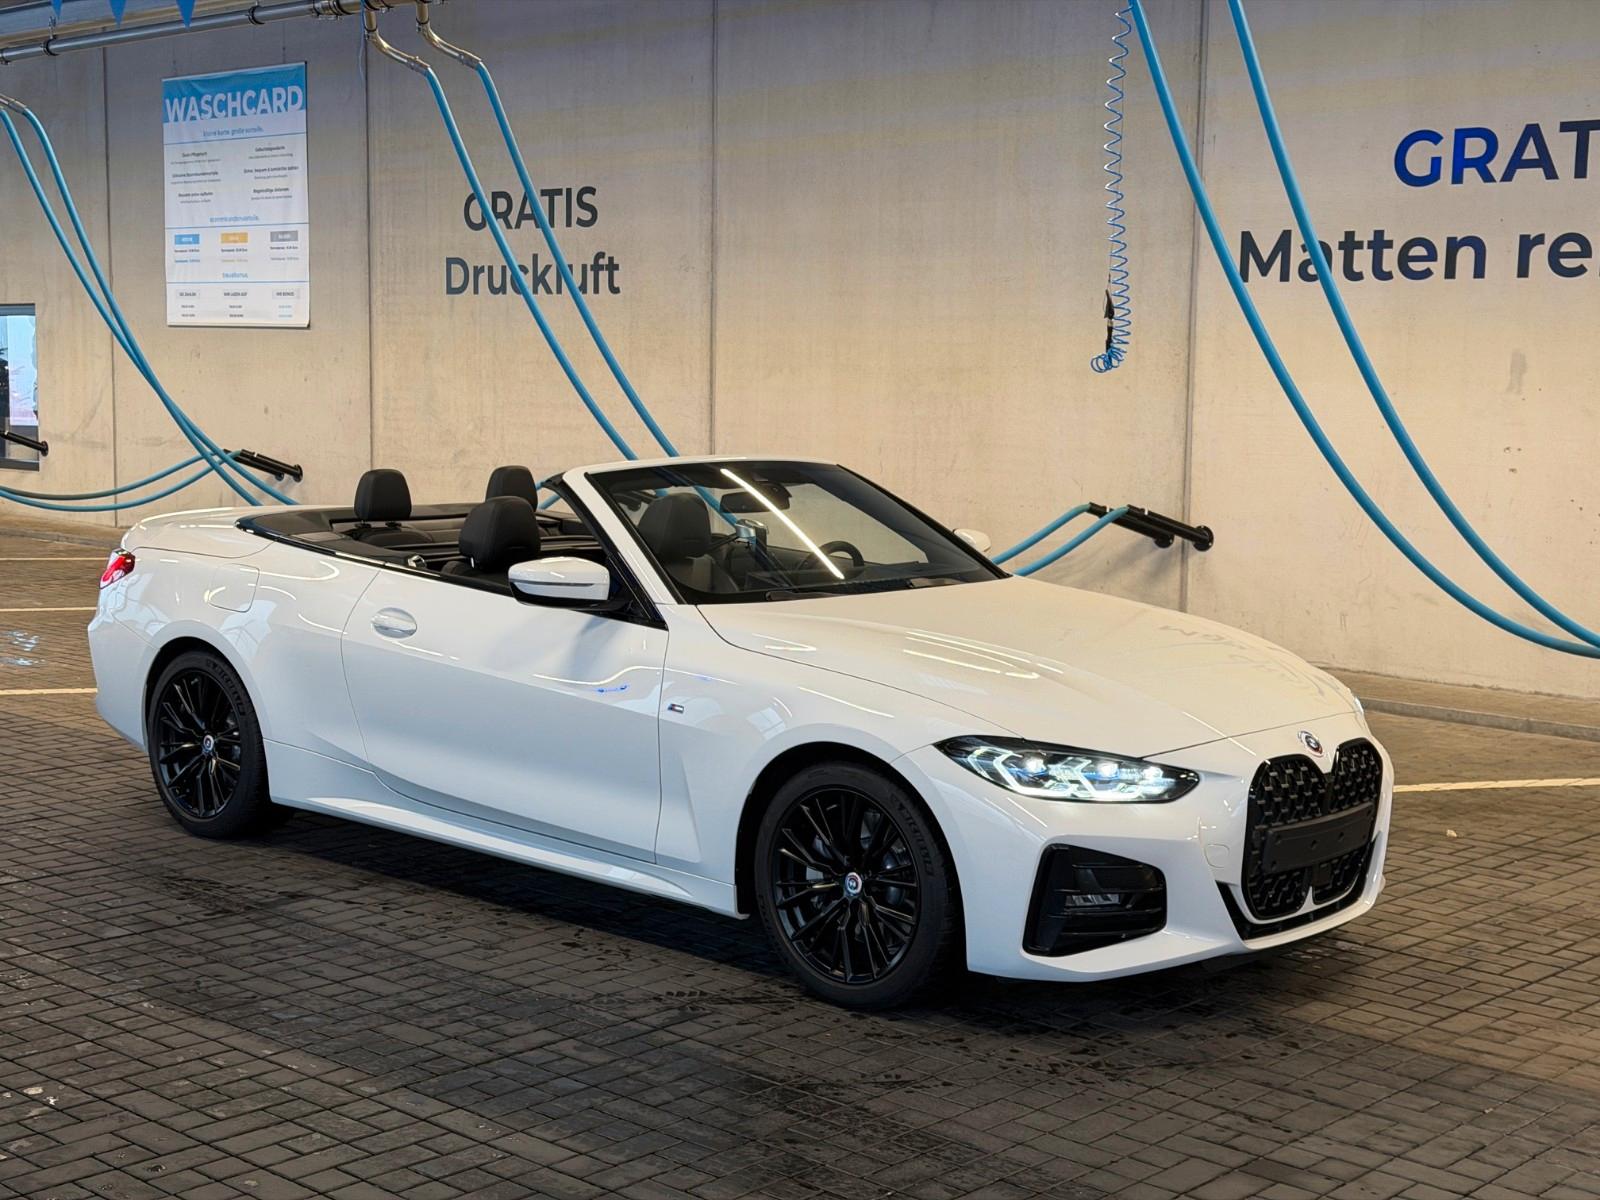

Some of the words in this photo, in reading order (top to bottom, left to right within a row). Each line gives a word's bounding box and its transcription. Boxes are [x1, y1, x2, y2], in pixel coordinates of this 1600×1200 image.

[165, 85, 303, 123] WASCHCARD
[1394, 119, 1600, 187] GRAT
[463, 186, 598, 231] GRATIS
[446, 251, 621, 296] Druckluft
[1239, 229, 1487, 283] Matten
[1516, 231, 1600, 279] re
